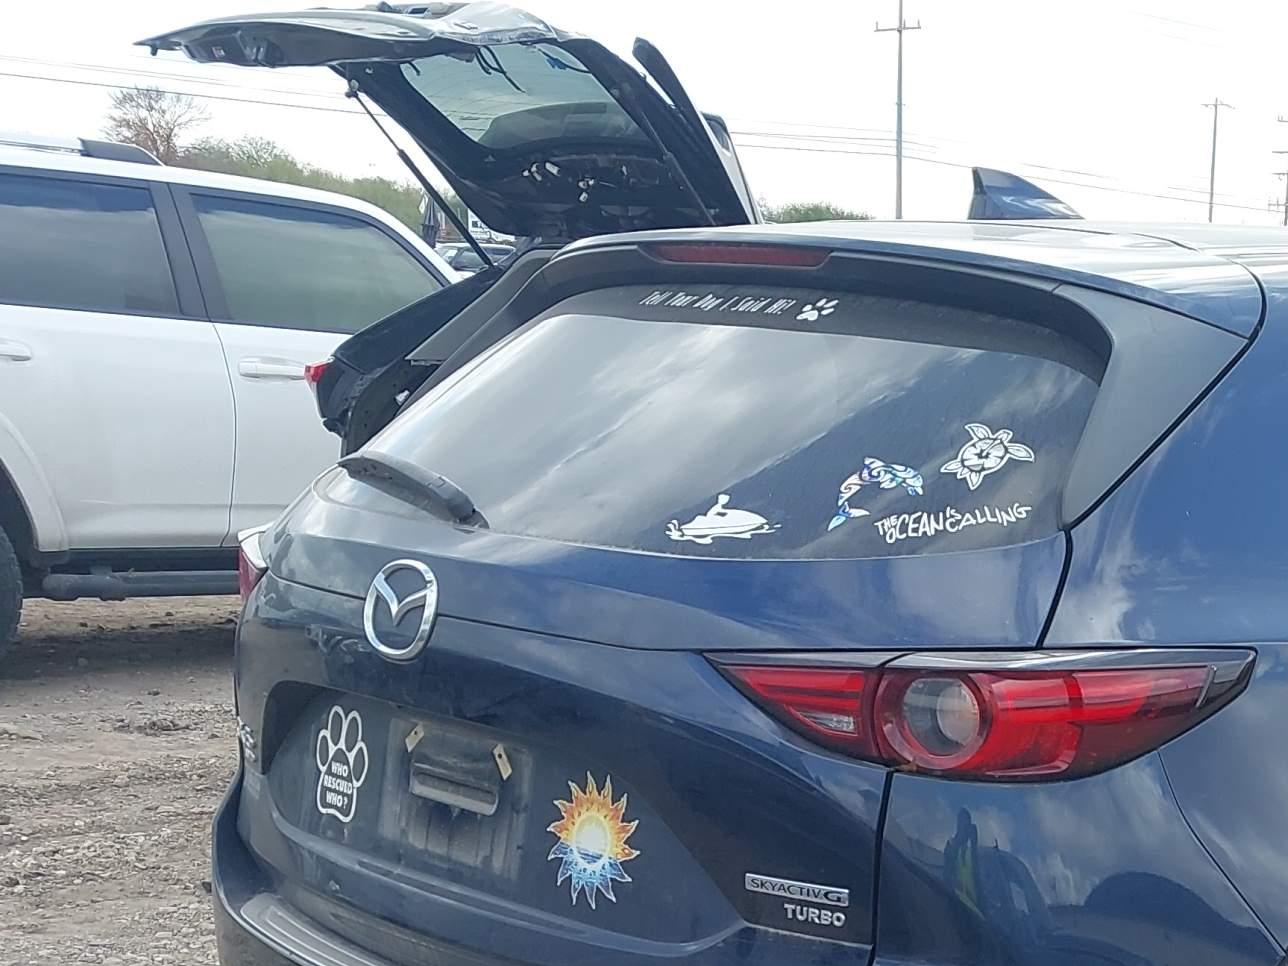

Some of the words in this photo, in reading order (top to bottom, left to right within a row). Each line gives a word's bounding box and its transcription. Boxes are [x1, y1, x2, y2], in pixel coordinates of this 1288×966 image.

[639, 290, 673, 305] Tell
[664, 291, 700, 307] Your
[692, 293, 725, 311] Dog
[719, 296, 740, 311] I
[730, 296, 772, 312] Said
[763, 298, 797, 315] Hi!
[945, 506, 962, 520] IS
[945, 503, 1032, 532] CALLING
[873, 514, 898, 536] THE
[885, 511, 944, 544] OCEAN
[331, 761, 349, 777] WHO
[323, 774, 352, 794] RESCUED
[783, 903, 846, 927] TURBO
